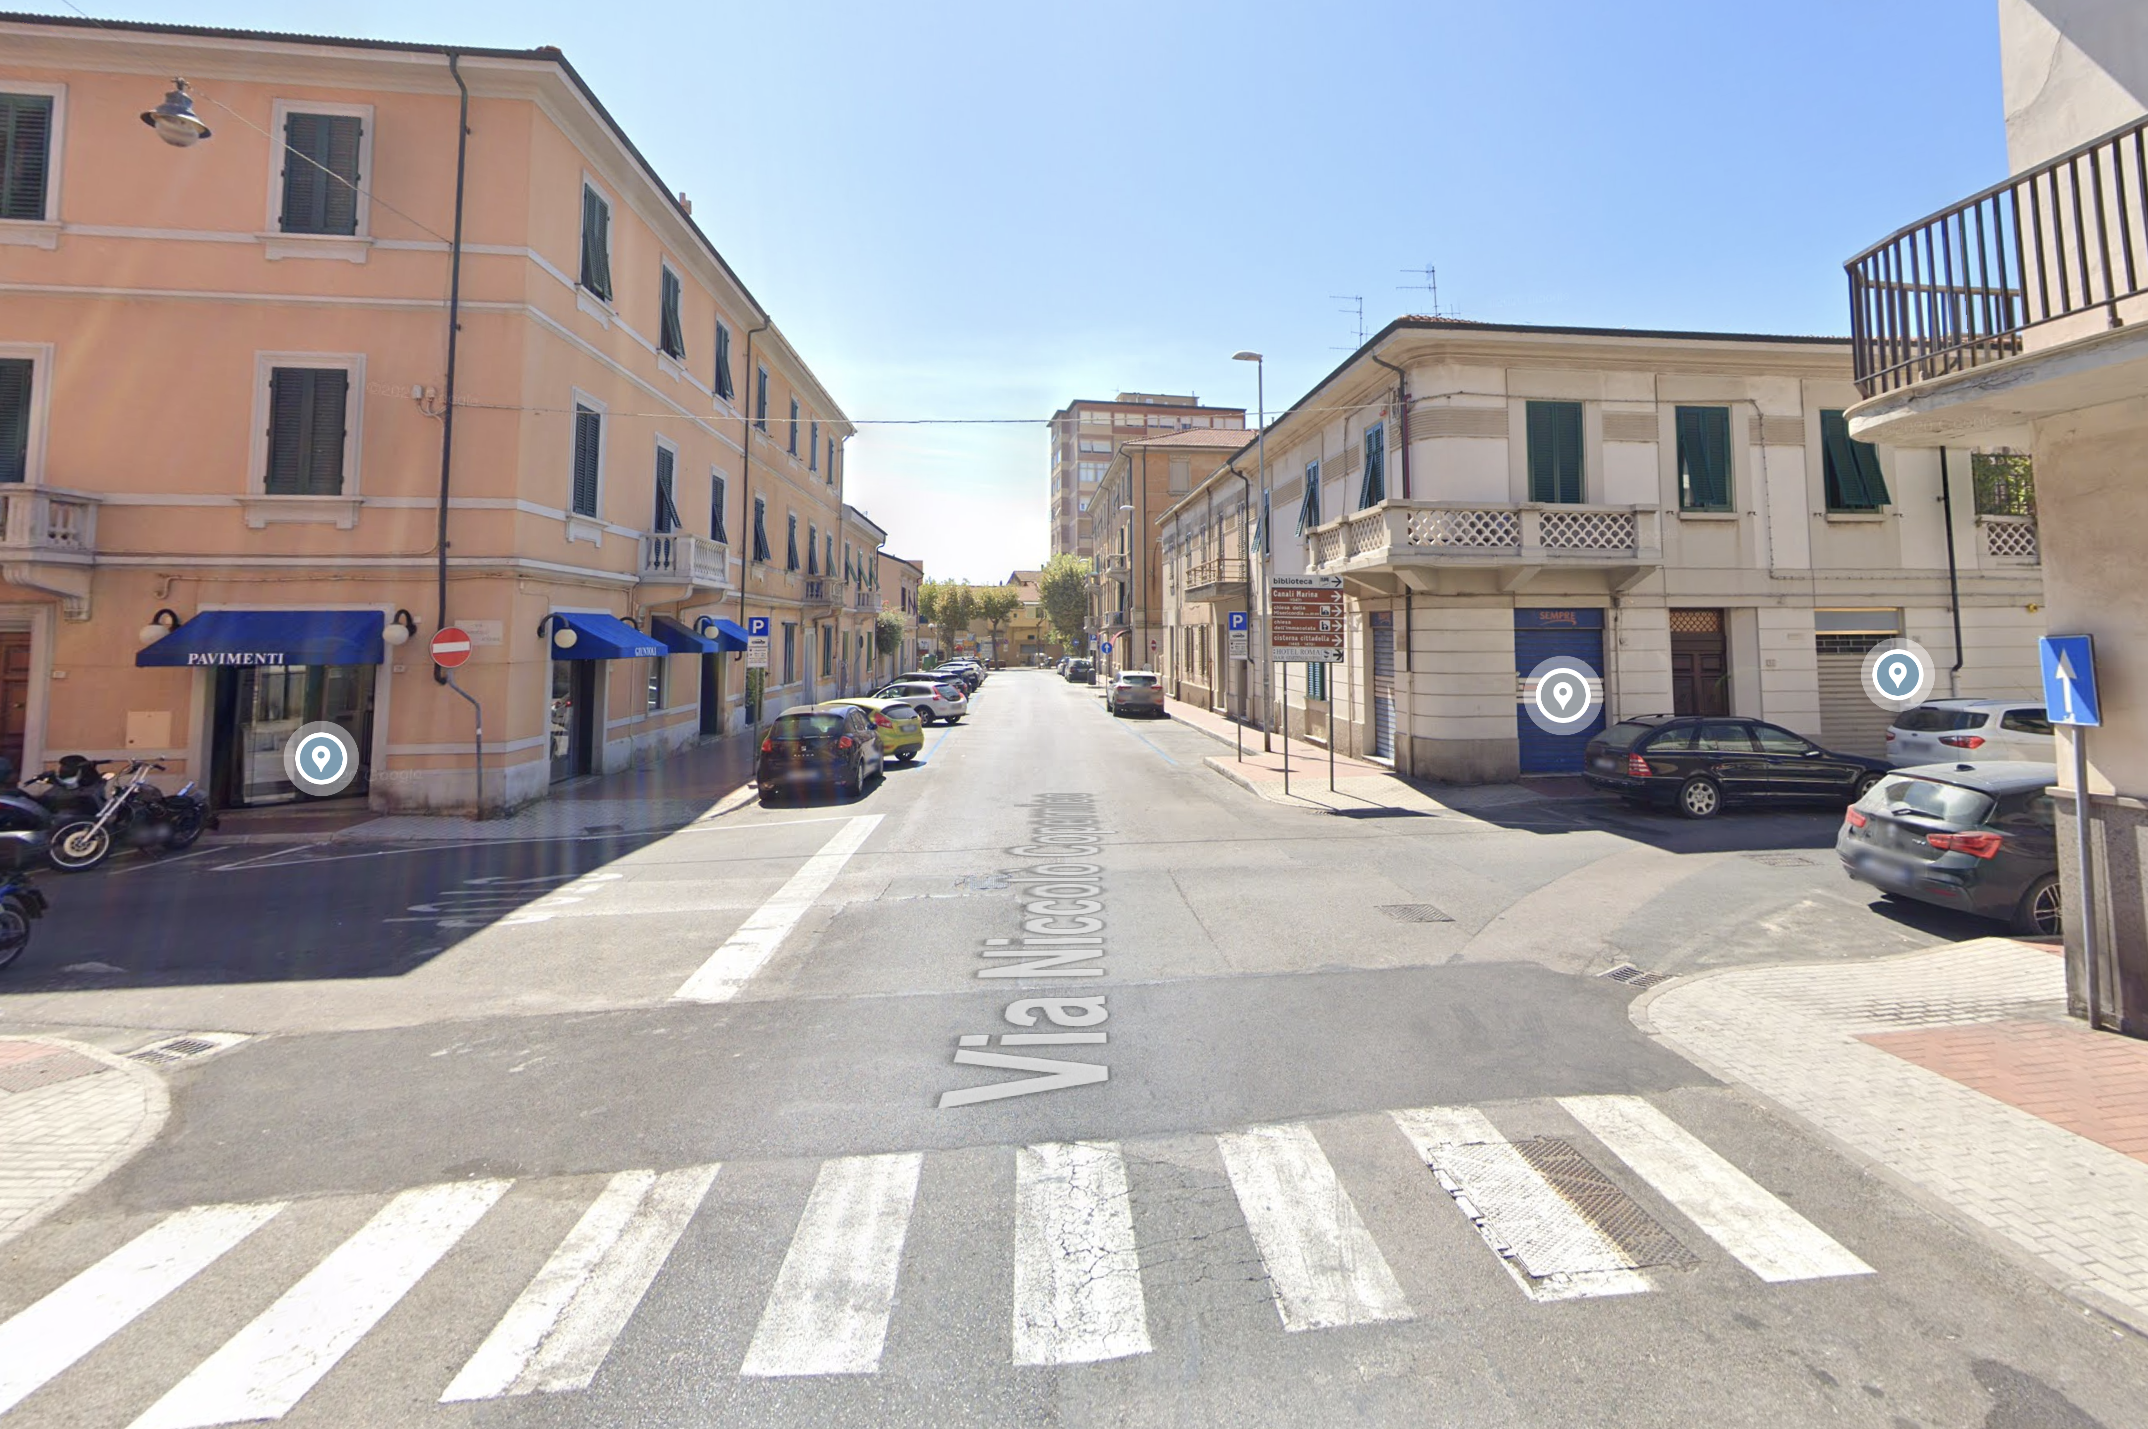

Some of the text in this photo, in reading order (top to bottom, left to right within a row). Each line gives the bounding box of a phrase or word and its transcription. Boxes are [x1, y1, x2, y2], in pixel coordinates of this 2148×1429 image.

[1273, 577, 1313, 585] biblioteca
[1232, 614, 1244, 628] P
[1539, 611, 1576, 620] SEMPRE
[752, 620, 765, 634] P
[187, 652, 285, 666] PAVIMENTI
